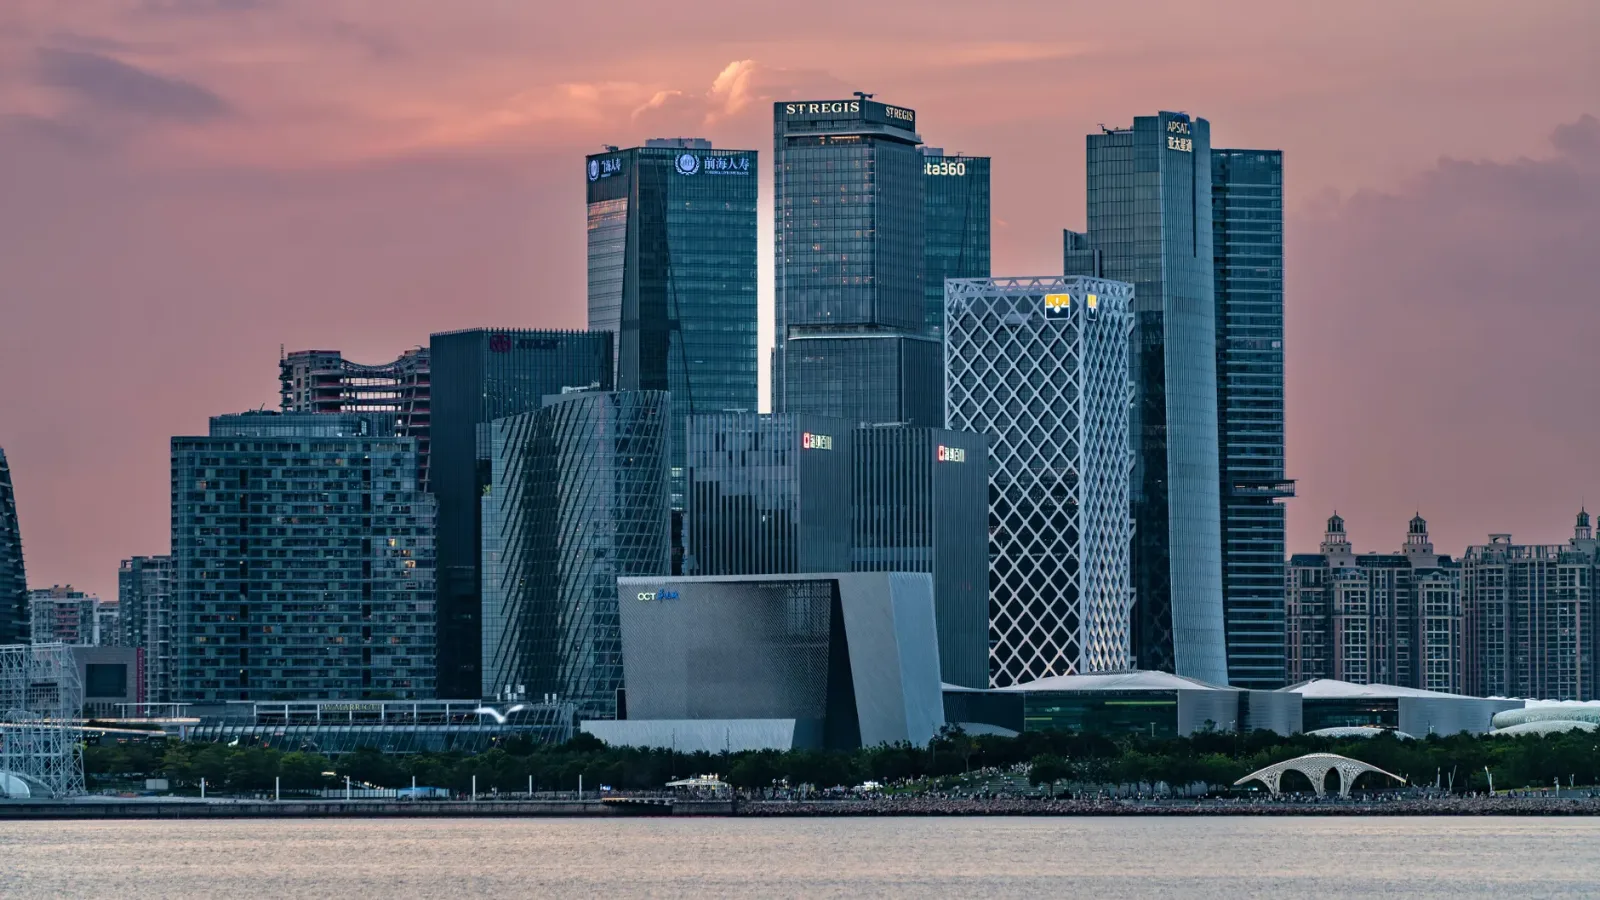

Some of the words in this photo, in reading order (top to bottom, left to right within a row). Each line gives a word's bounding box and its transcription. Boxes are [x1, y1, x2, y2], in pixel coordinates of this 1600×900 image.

[809, 101, 860, 114] REGIS
[894, 108, 914, 122] REGIS
[703, 156, 750, 171] 前海人寿
[637, 592, 656, 601] OCT
